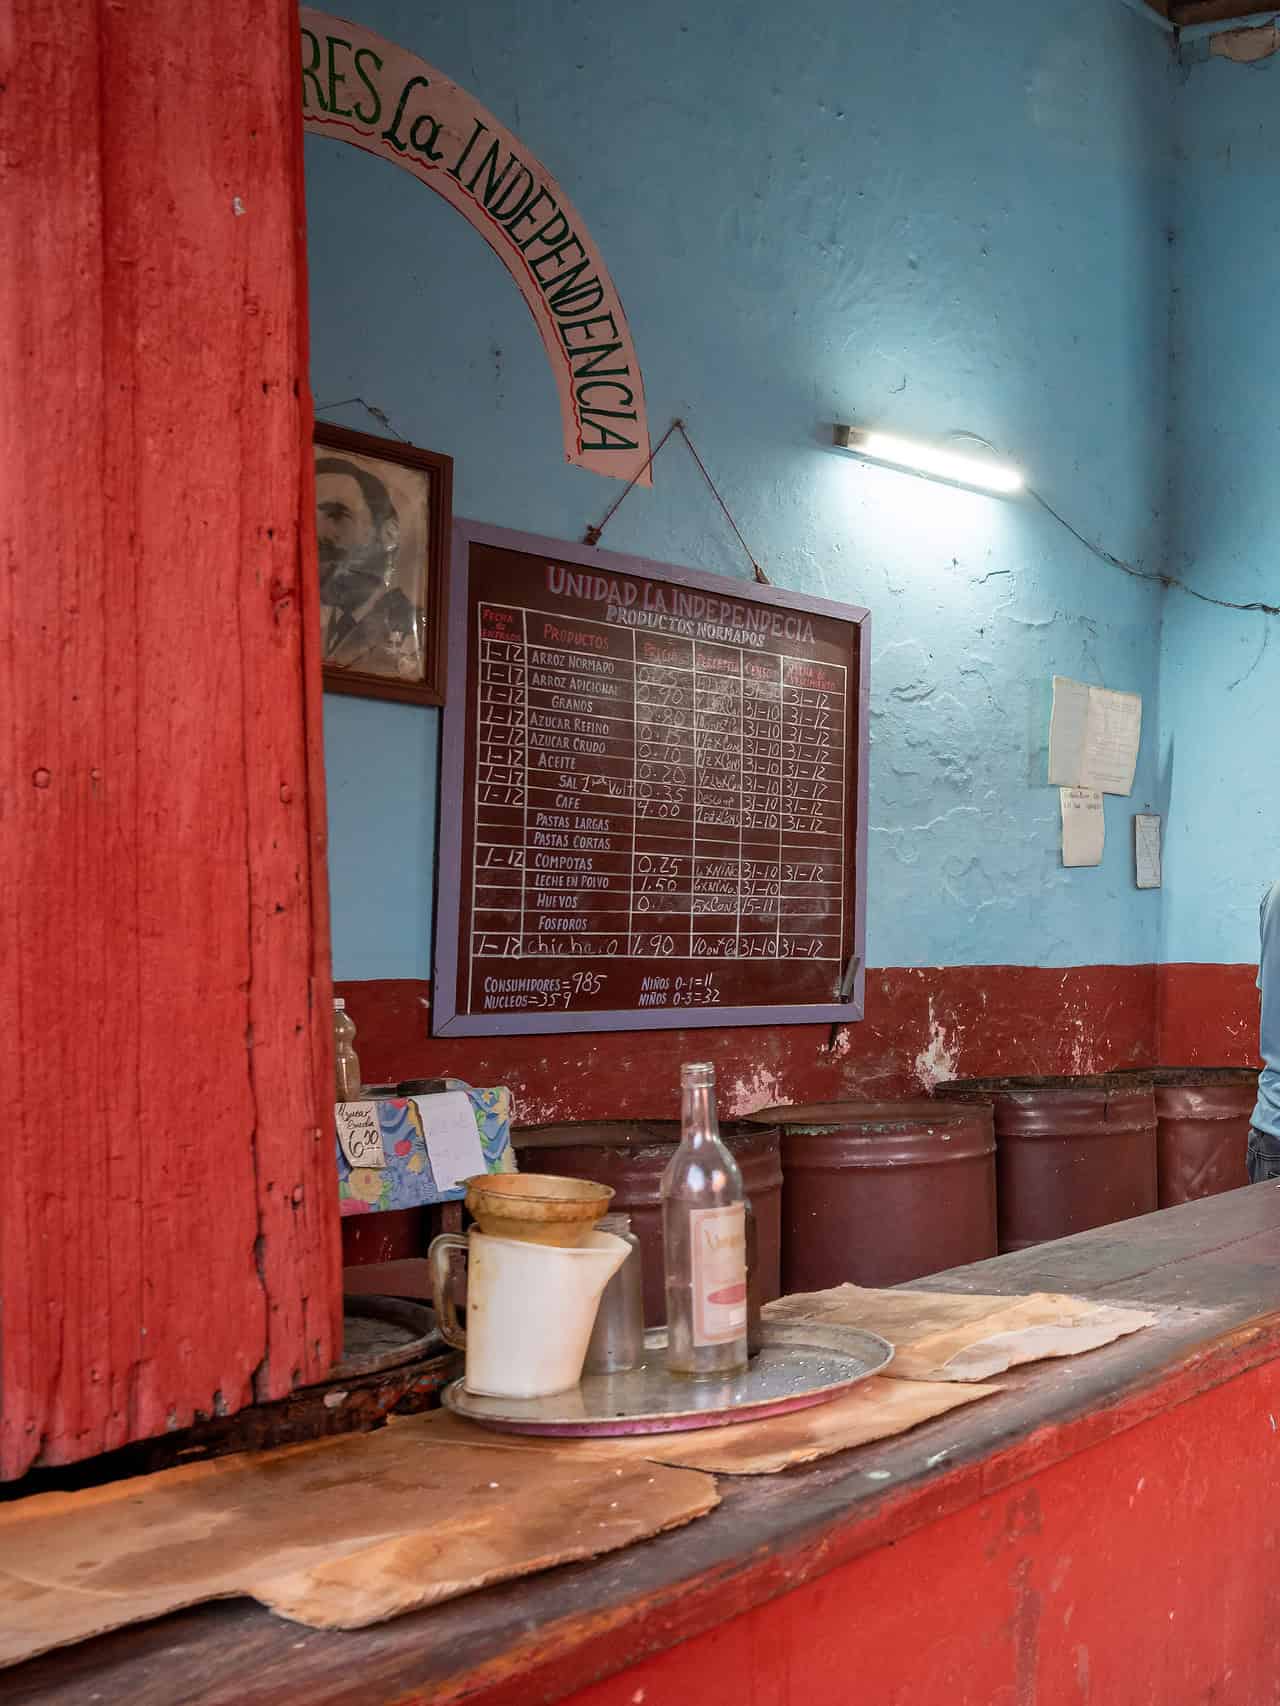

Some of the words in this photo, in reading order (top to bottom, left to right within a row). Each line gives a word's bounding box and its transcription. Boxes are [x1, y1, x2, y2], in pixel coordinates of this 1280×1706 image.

[382, 75, 444, 161] La
[446, 117, 640, 452] INDEPENDENCIA
[545, 565, 638, 605] UNIDAD
[643, 582, 667, 613] LA
[671, 588, 817, 645] INDEPENDECIA
[605, 604, 697, 635] PRODUCTOS
[697, 621, 767, 649] NORMADOS
[543, 623, 609, 650] PRODUCTOS
[531, 651, 565, 667] ARROZ
[568, 656, 615, 674] NORMADO
[531, 672, 566, 689] ARROZ
[551, 695, 593, 713] GRANOS
[530, 712, 570, 729] AZUCAR
[574, 718, 609, 735] REFINO
[530, 733, 570, 749] AZUCAR
[573, 737, 606, 753] CRUDO
[538, 751, 576, 769] ACEITE
[558, 775, 578, 790] SAL
[555, 794, 581, 809] CAFE
[535, 813, 570, 828] PASTAS
[575, 816, 609, 831] LARGAS
[534, 831, 569, 848] PASTAS
[573, 834, 611, 850] CORTAS
[535, 853, 593, 871] COMPOTAS
[535, 874, 565, 887] LECHE
[566, 875, 578, 887] EN
[581, 876, 609, 889] POLVO
[536, 893, 578, 909] HUEVOS
[538, 915, 588, 931] FOSFOROS
[641, 975, 670, 991] NIÑOS
[639, 991, 668, 1007] NIÑOS
